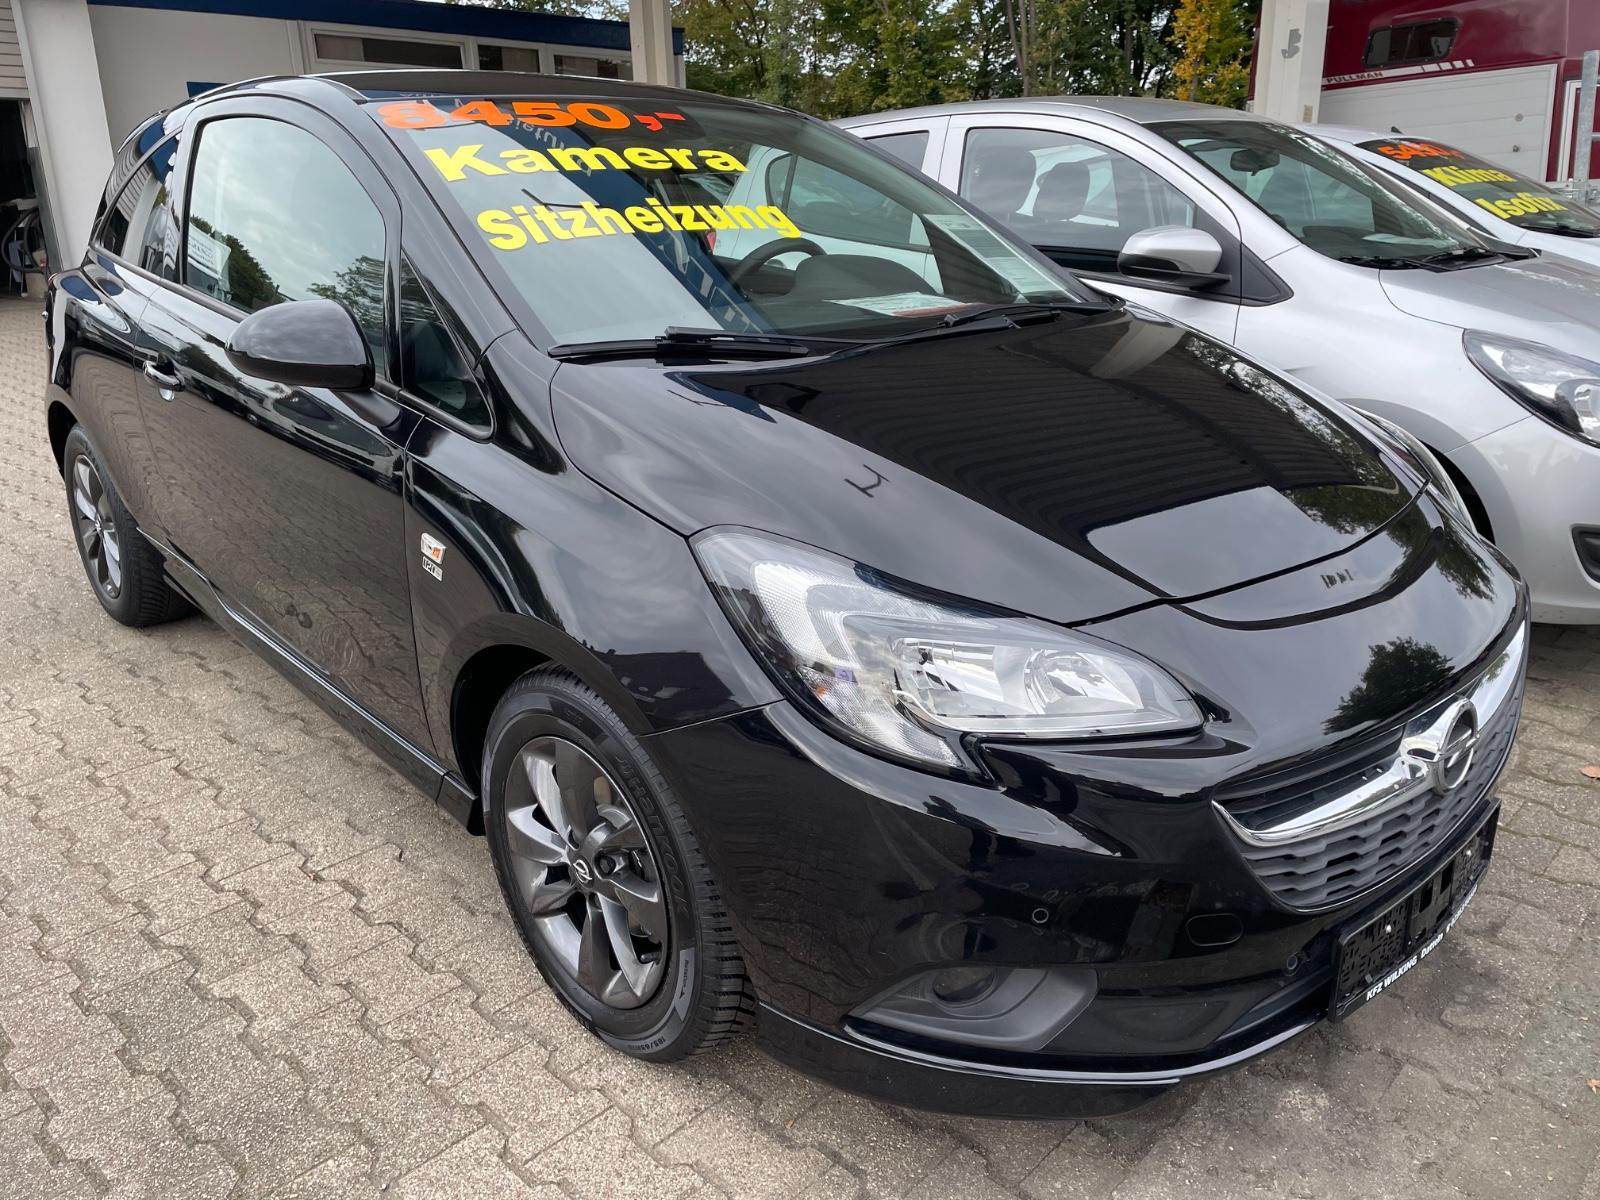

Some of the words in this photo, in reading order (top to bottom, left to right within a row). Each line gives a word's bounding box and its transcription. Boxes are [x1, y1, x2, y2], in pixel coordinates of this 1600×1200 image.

[1326, 71, 1383, 83] PULLMAN
[424, 144, 749, 182] Kamera
[1423, 166, 1518, 187] Klima
[1475, 192, 1568, 219] Isofix
[476, 197, 802, 250] Sitzheizung
[1366, 981, 1383, 1001] KFZ
[1384, 955, 1418, 988] WILKING
